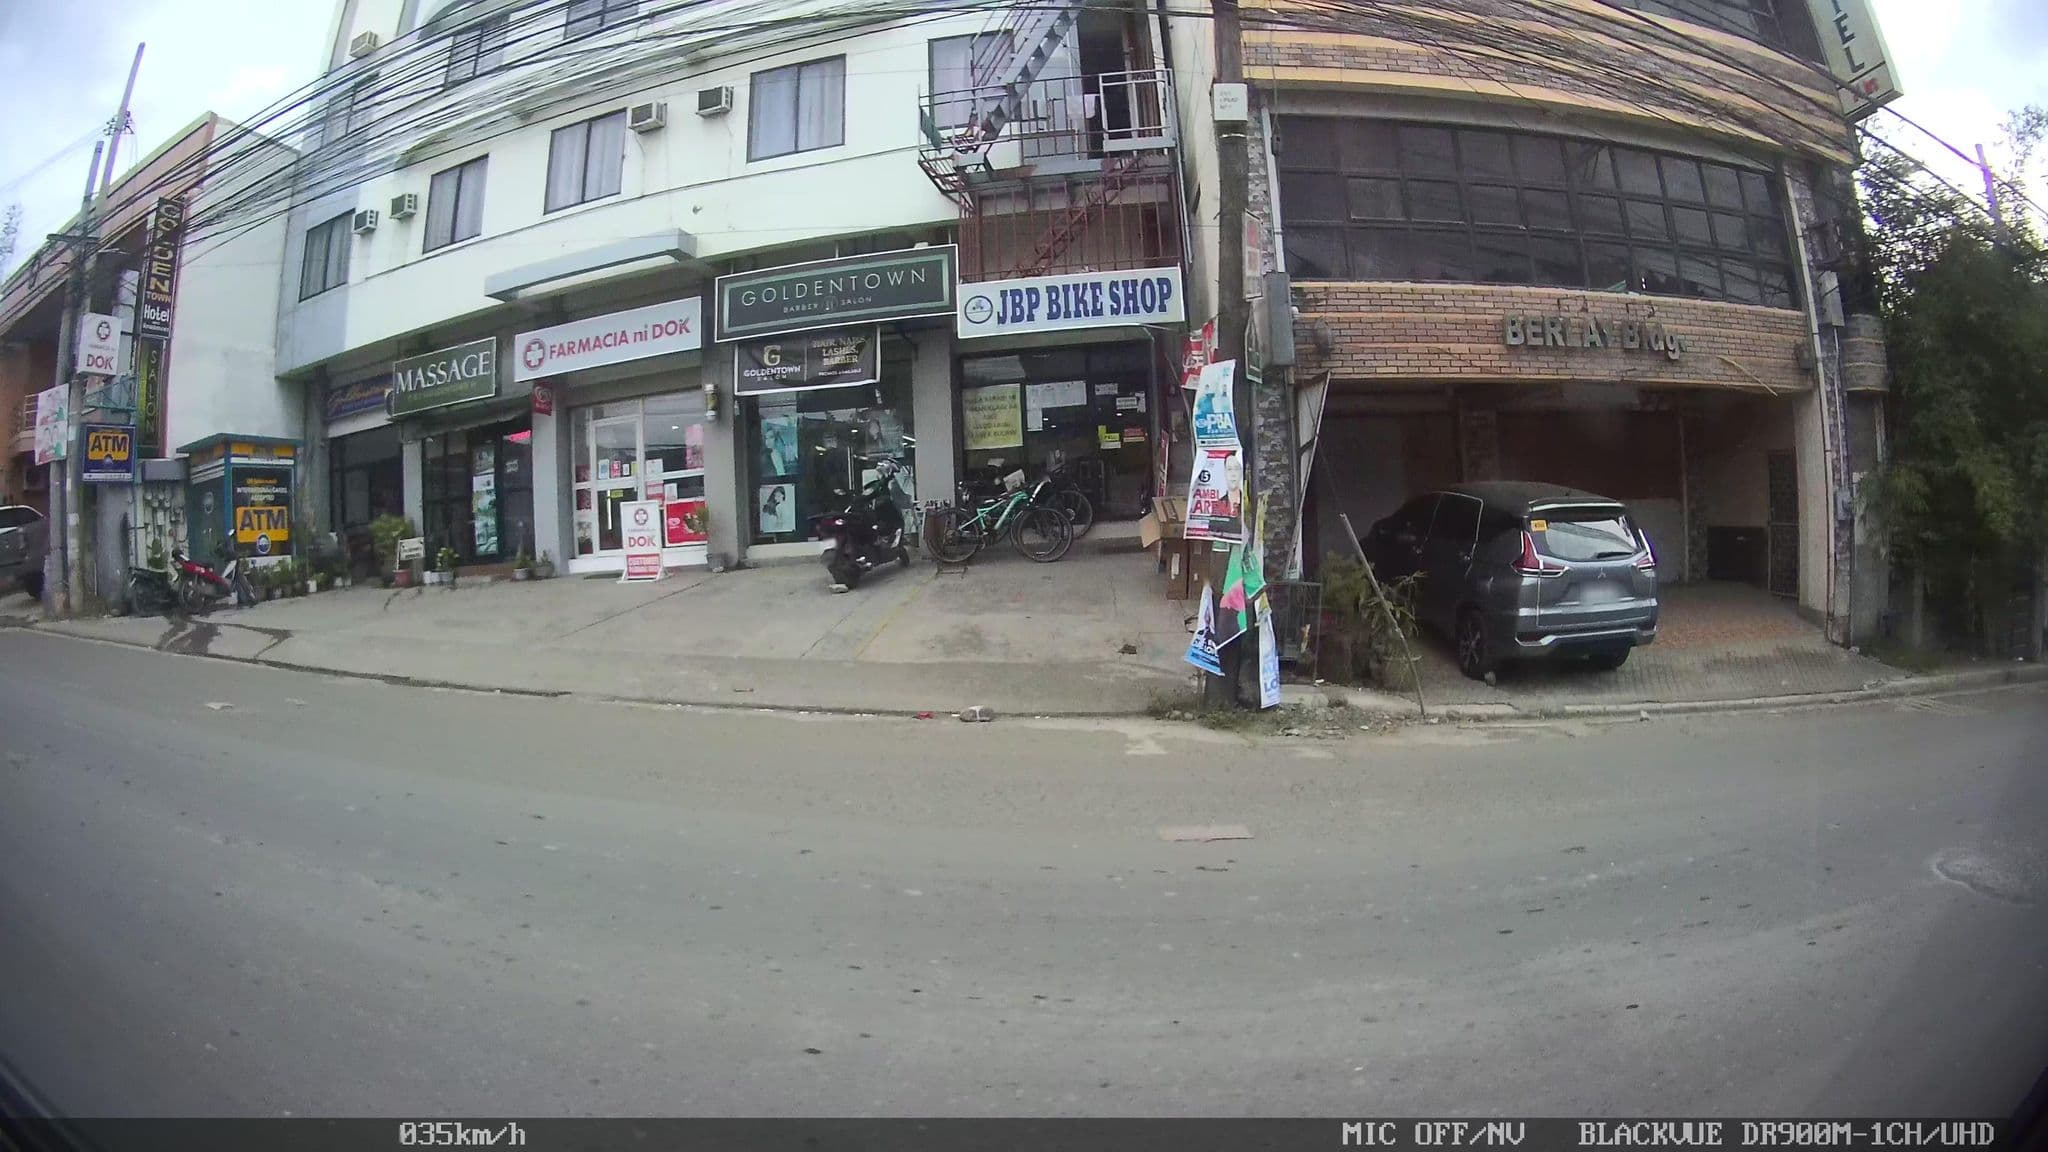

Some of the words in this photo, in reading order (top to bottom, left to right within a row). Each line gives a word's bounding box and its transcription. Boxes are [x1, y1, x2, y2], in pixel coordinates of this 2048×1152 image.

[741, 267, 926, 306] GOLDENTOWN
[146, 291, 171, 303] TOWN
[783, 303, 819, 314] BARBER
[840, 295, 872, 306] SALON
[997, 286, 1041, 325] JBP
[1046, 281, 1104, 321] BIKE
[1109, 277, 1173, 316] SHOP
[143, 304, 170, 322] Hotel
[550, 330, 629, 360] FARMACIA
[633, 324, 648, 343] ni
[652, 317, 691, 340] DOK
[86, 353, 114, 370] DOK
[743, 365, 801, 378] GOLDENTOWN
[396, 351, 491, 394] MASSAGE
[145, 350, 158, 434] SALON
[91, 433, 128, 453] ATM
[240, 508, 287, 531] ATM
[628, 536, 657, 548] DOK
